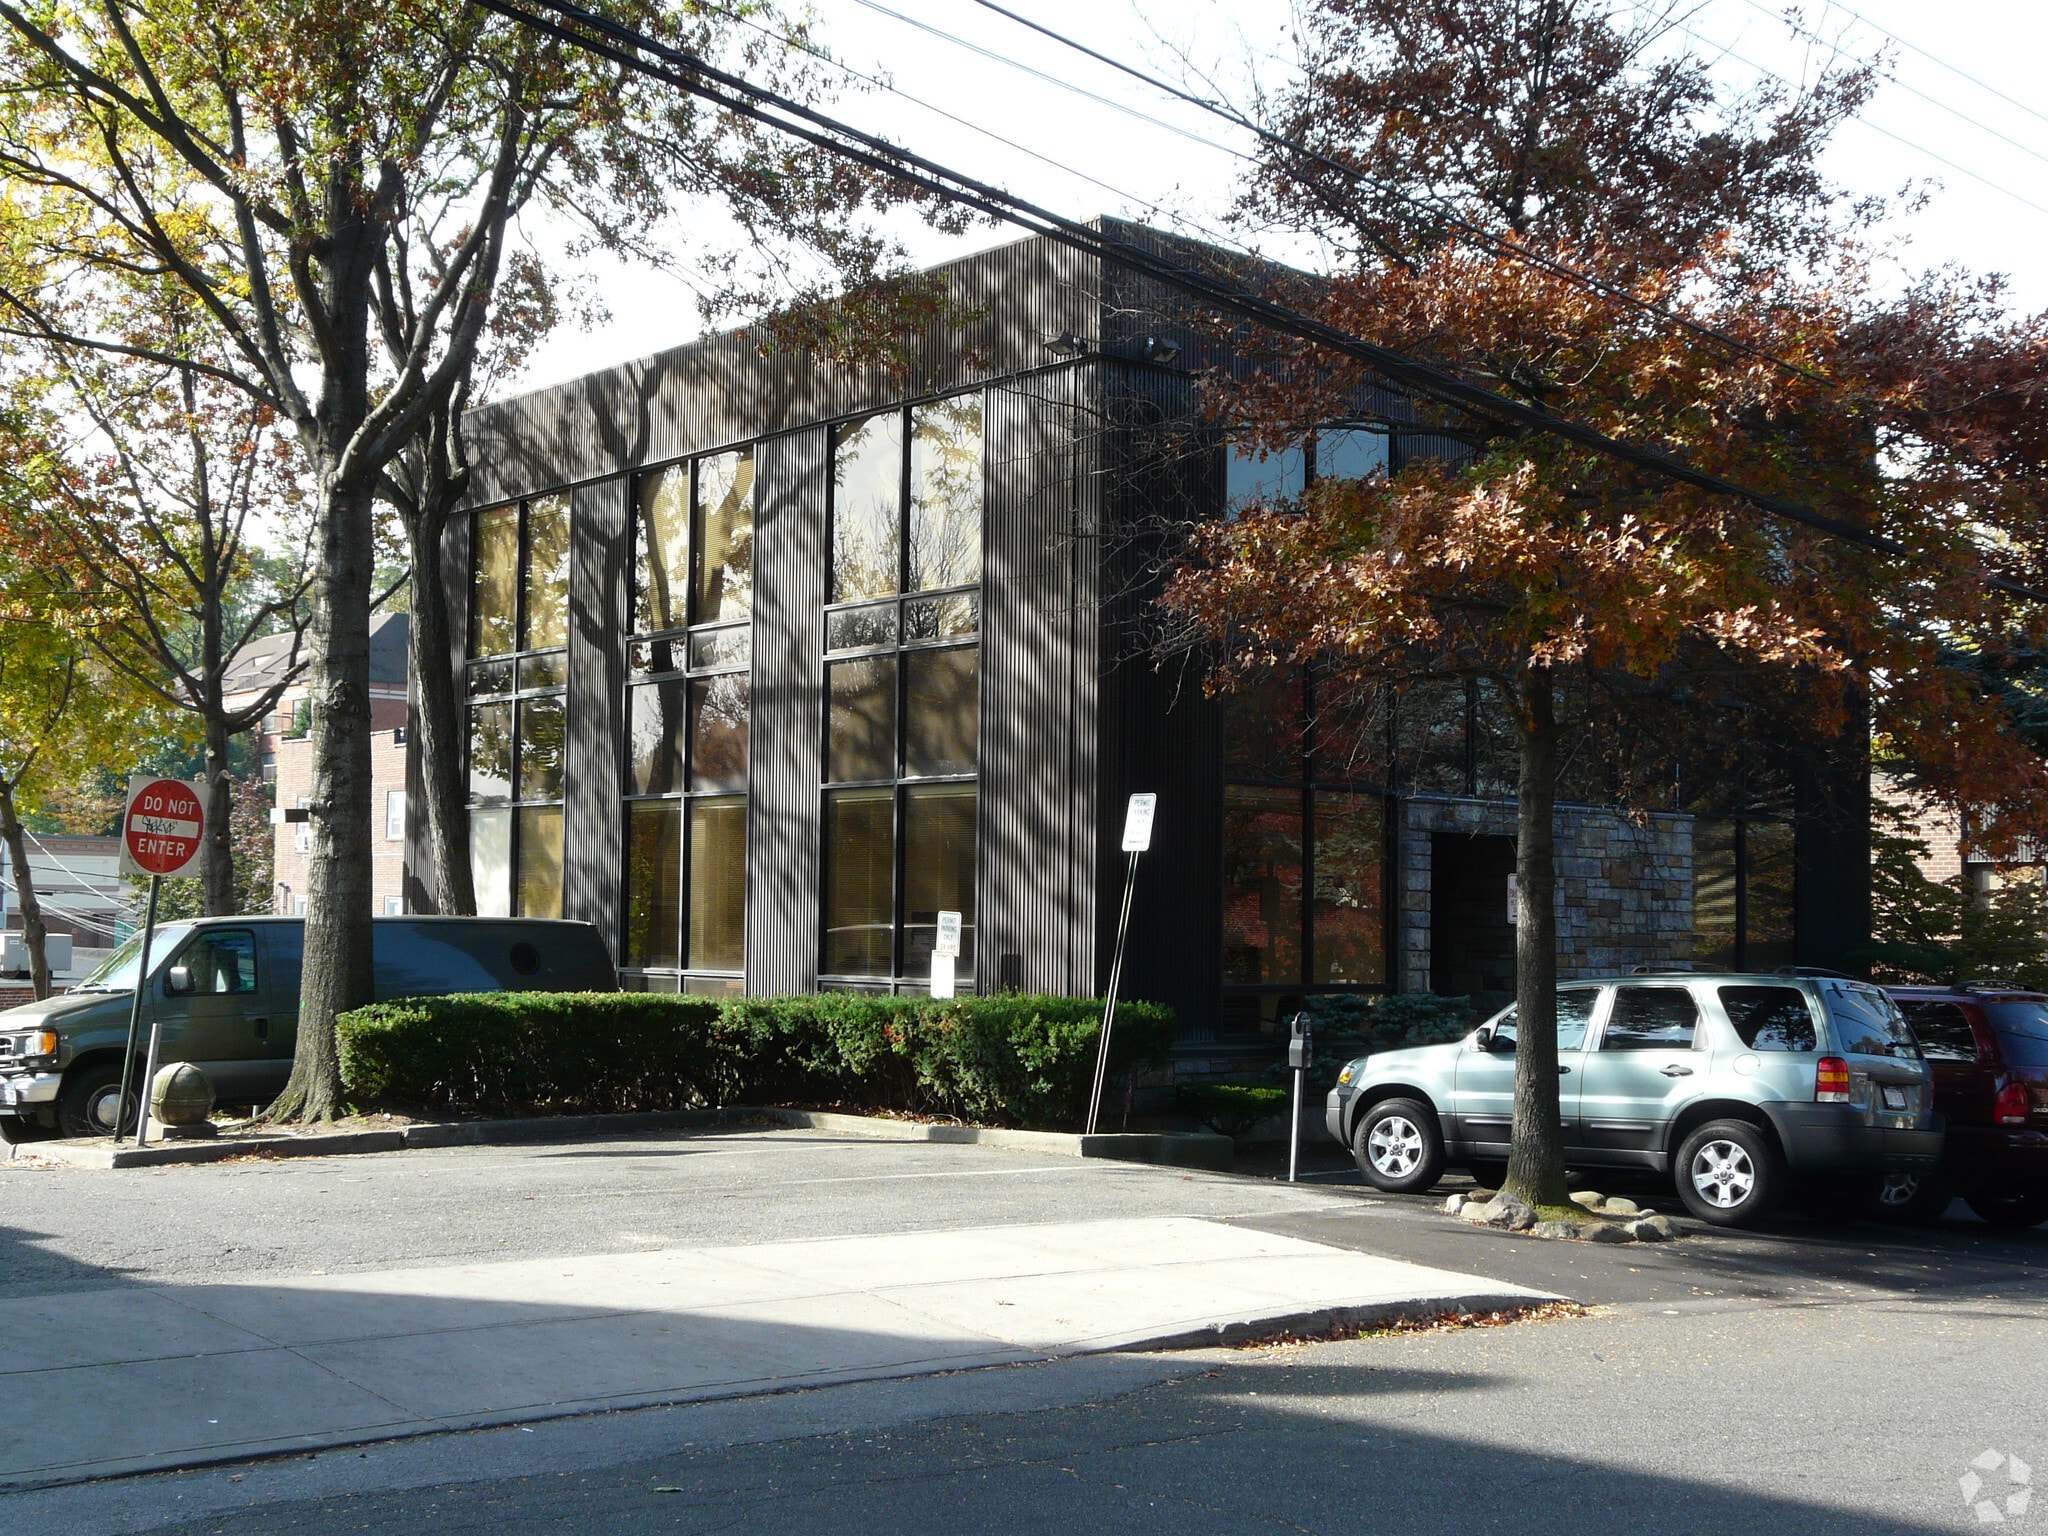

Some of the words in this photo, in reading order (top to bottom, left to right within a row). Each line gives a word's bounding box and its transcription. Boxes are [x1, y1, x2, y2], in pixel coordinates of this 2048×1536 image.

[144, 796, 162, 811] DO
[168, 799, 195, 815] NOT
[138, 838, 185, 857] ENTER
[942, 916, 957, 924] PERMIT
[940, 925, 957, 933] PARKING
